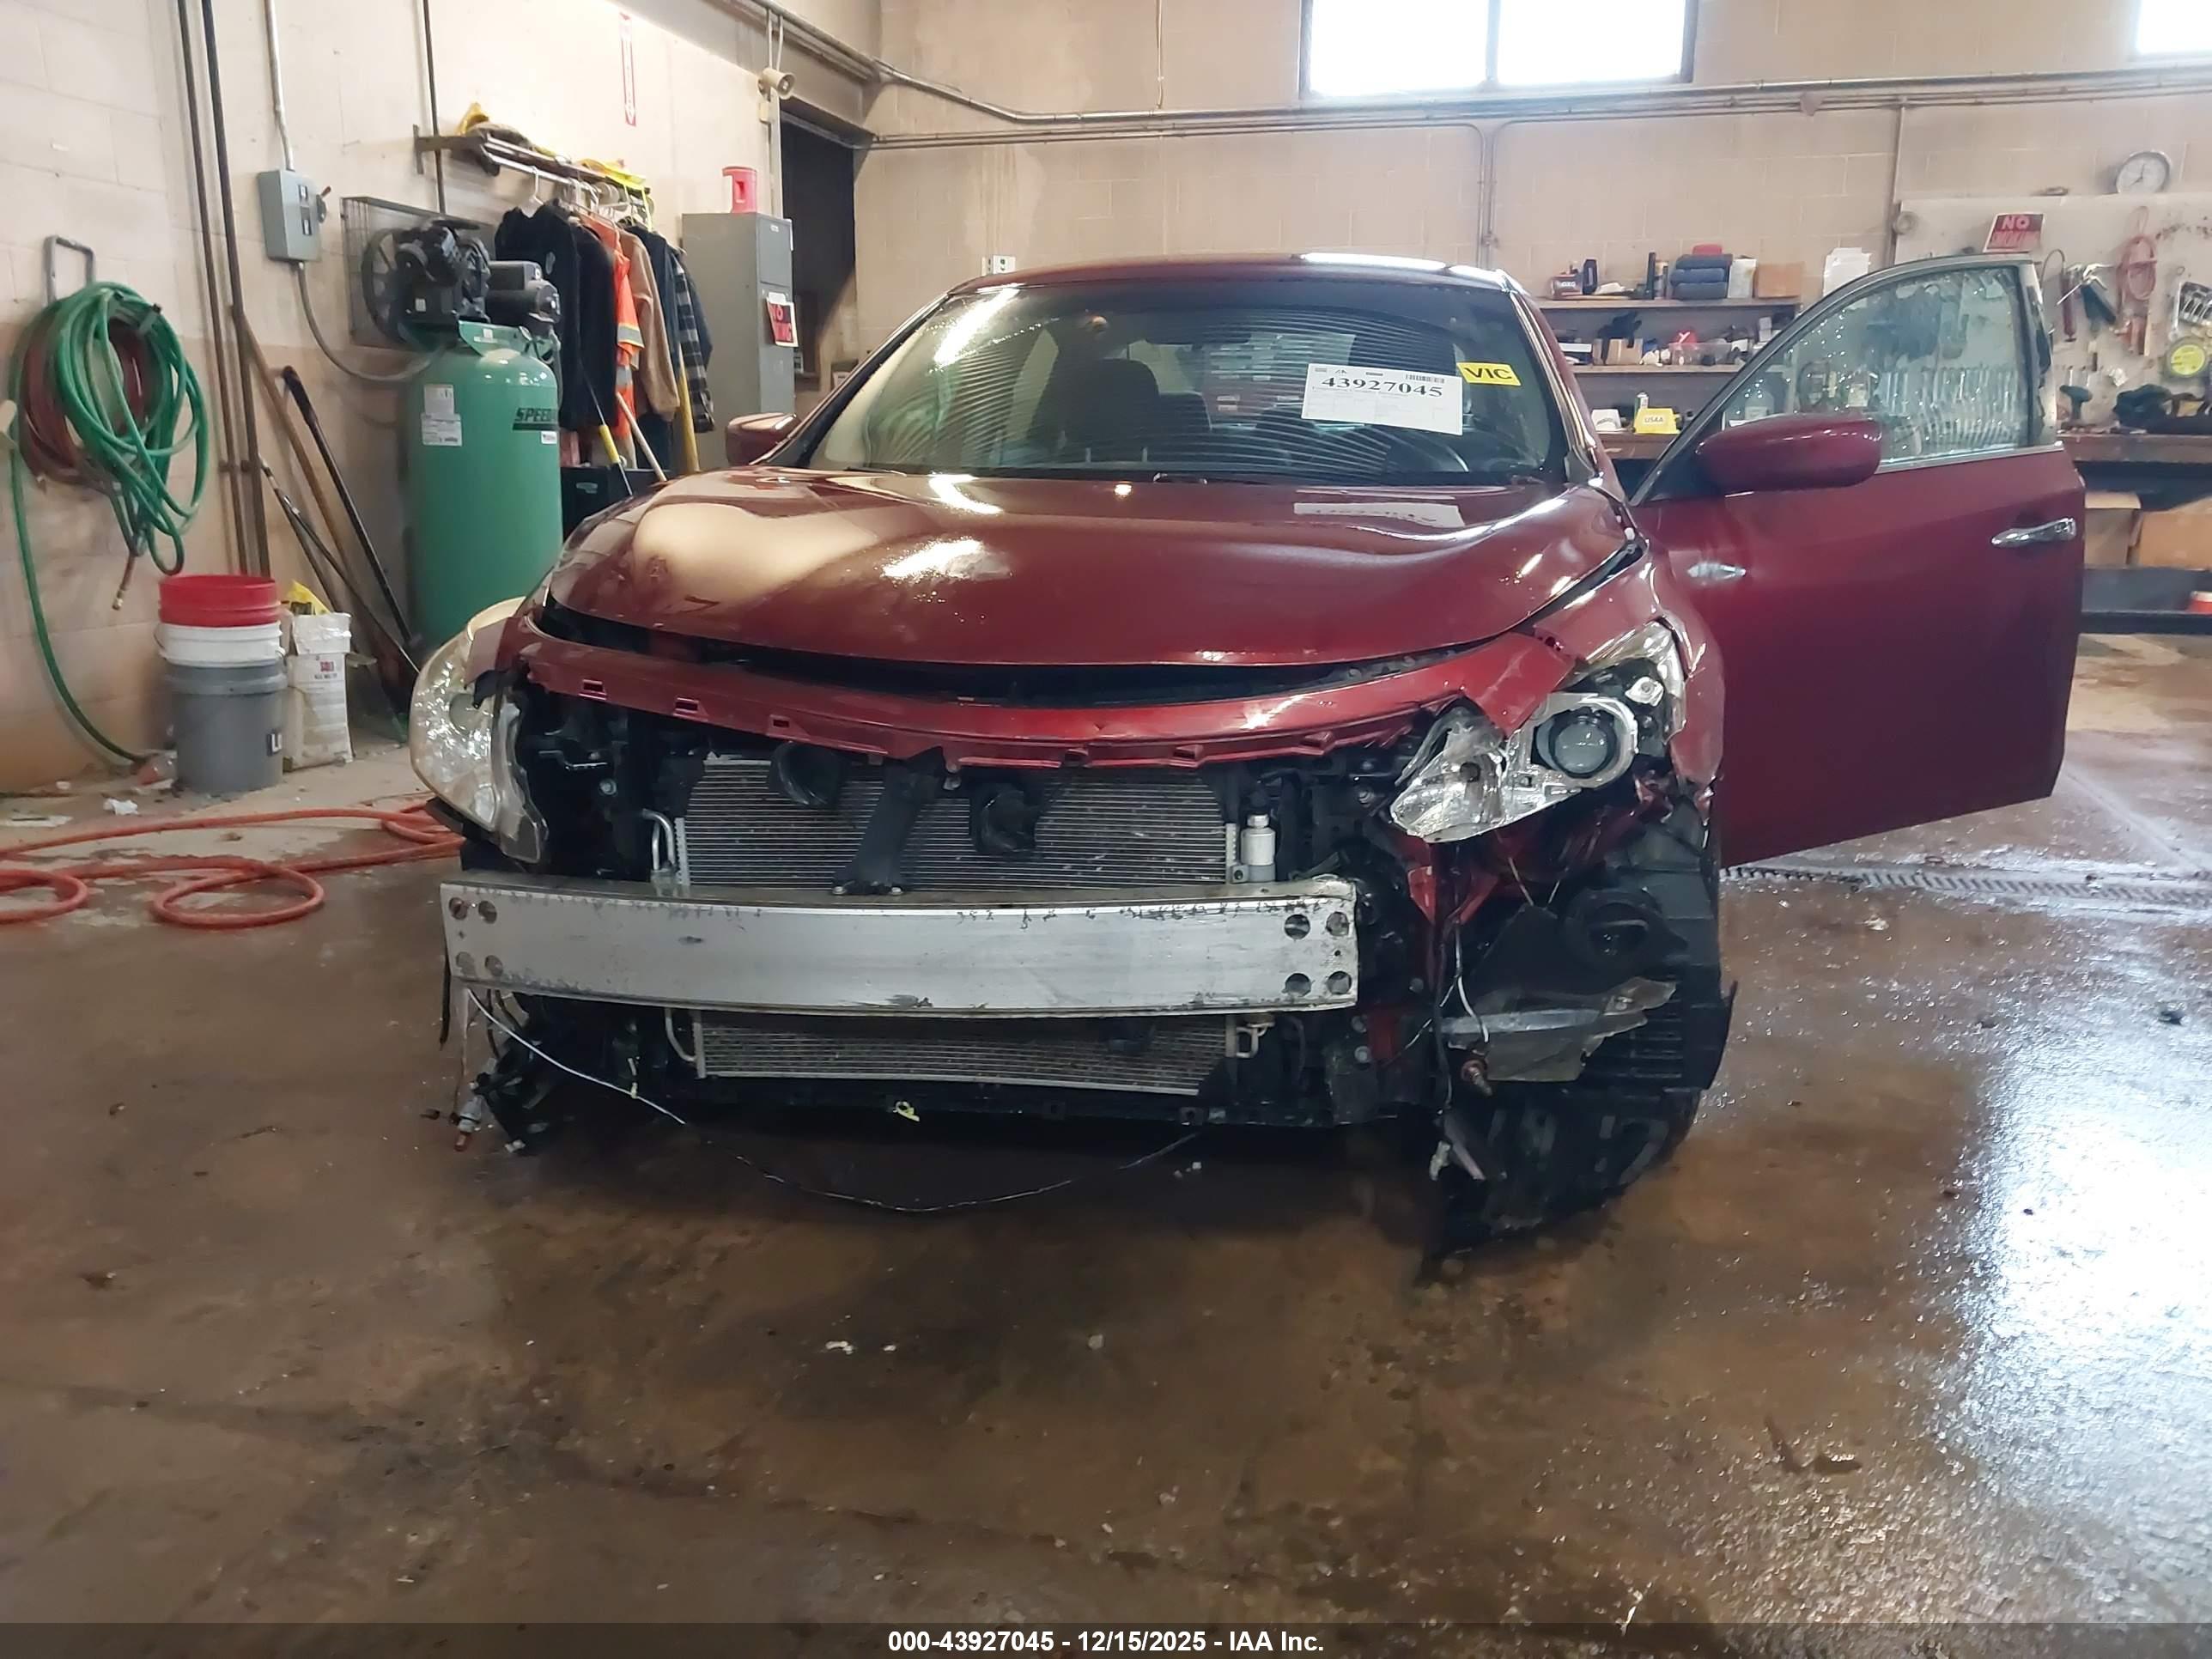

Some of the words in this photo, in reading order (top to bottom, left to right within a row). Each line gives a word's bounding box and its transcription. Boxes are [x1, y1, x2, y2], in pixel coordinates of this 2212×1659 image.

[2002, 216, 2030, 230] NO
[1463, 367, 1513, 380] VIC
[1322, 376, 1443, 398] 43927045
